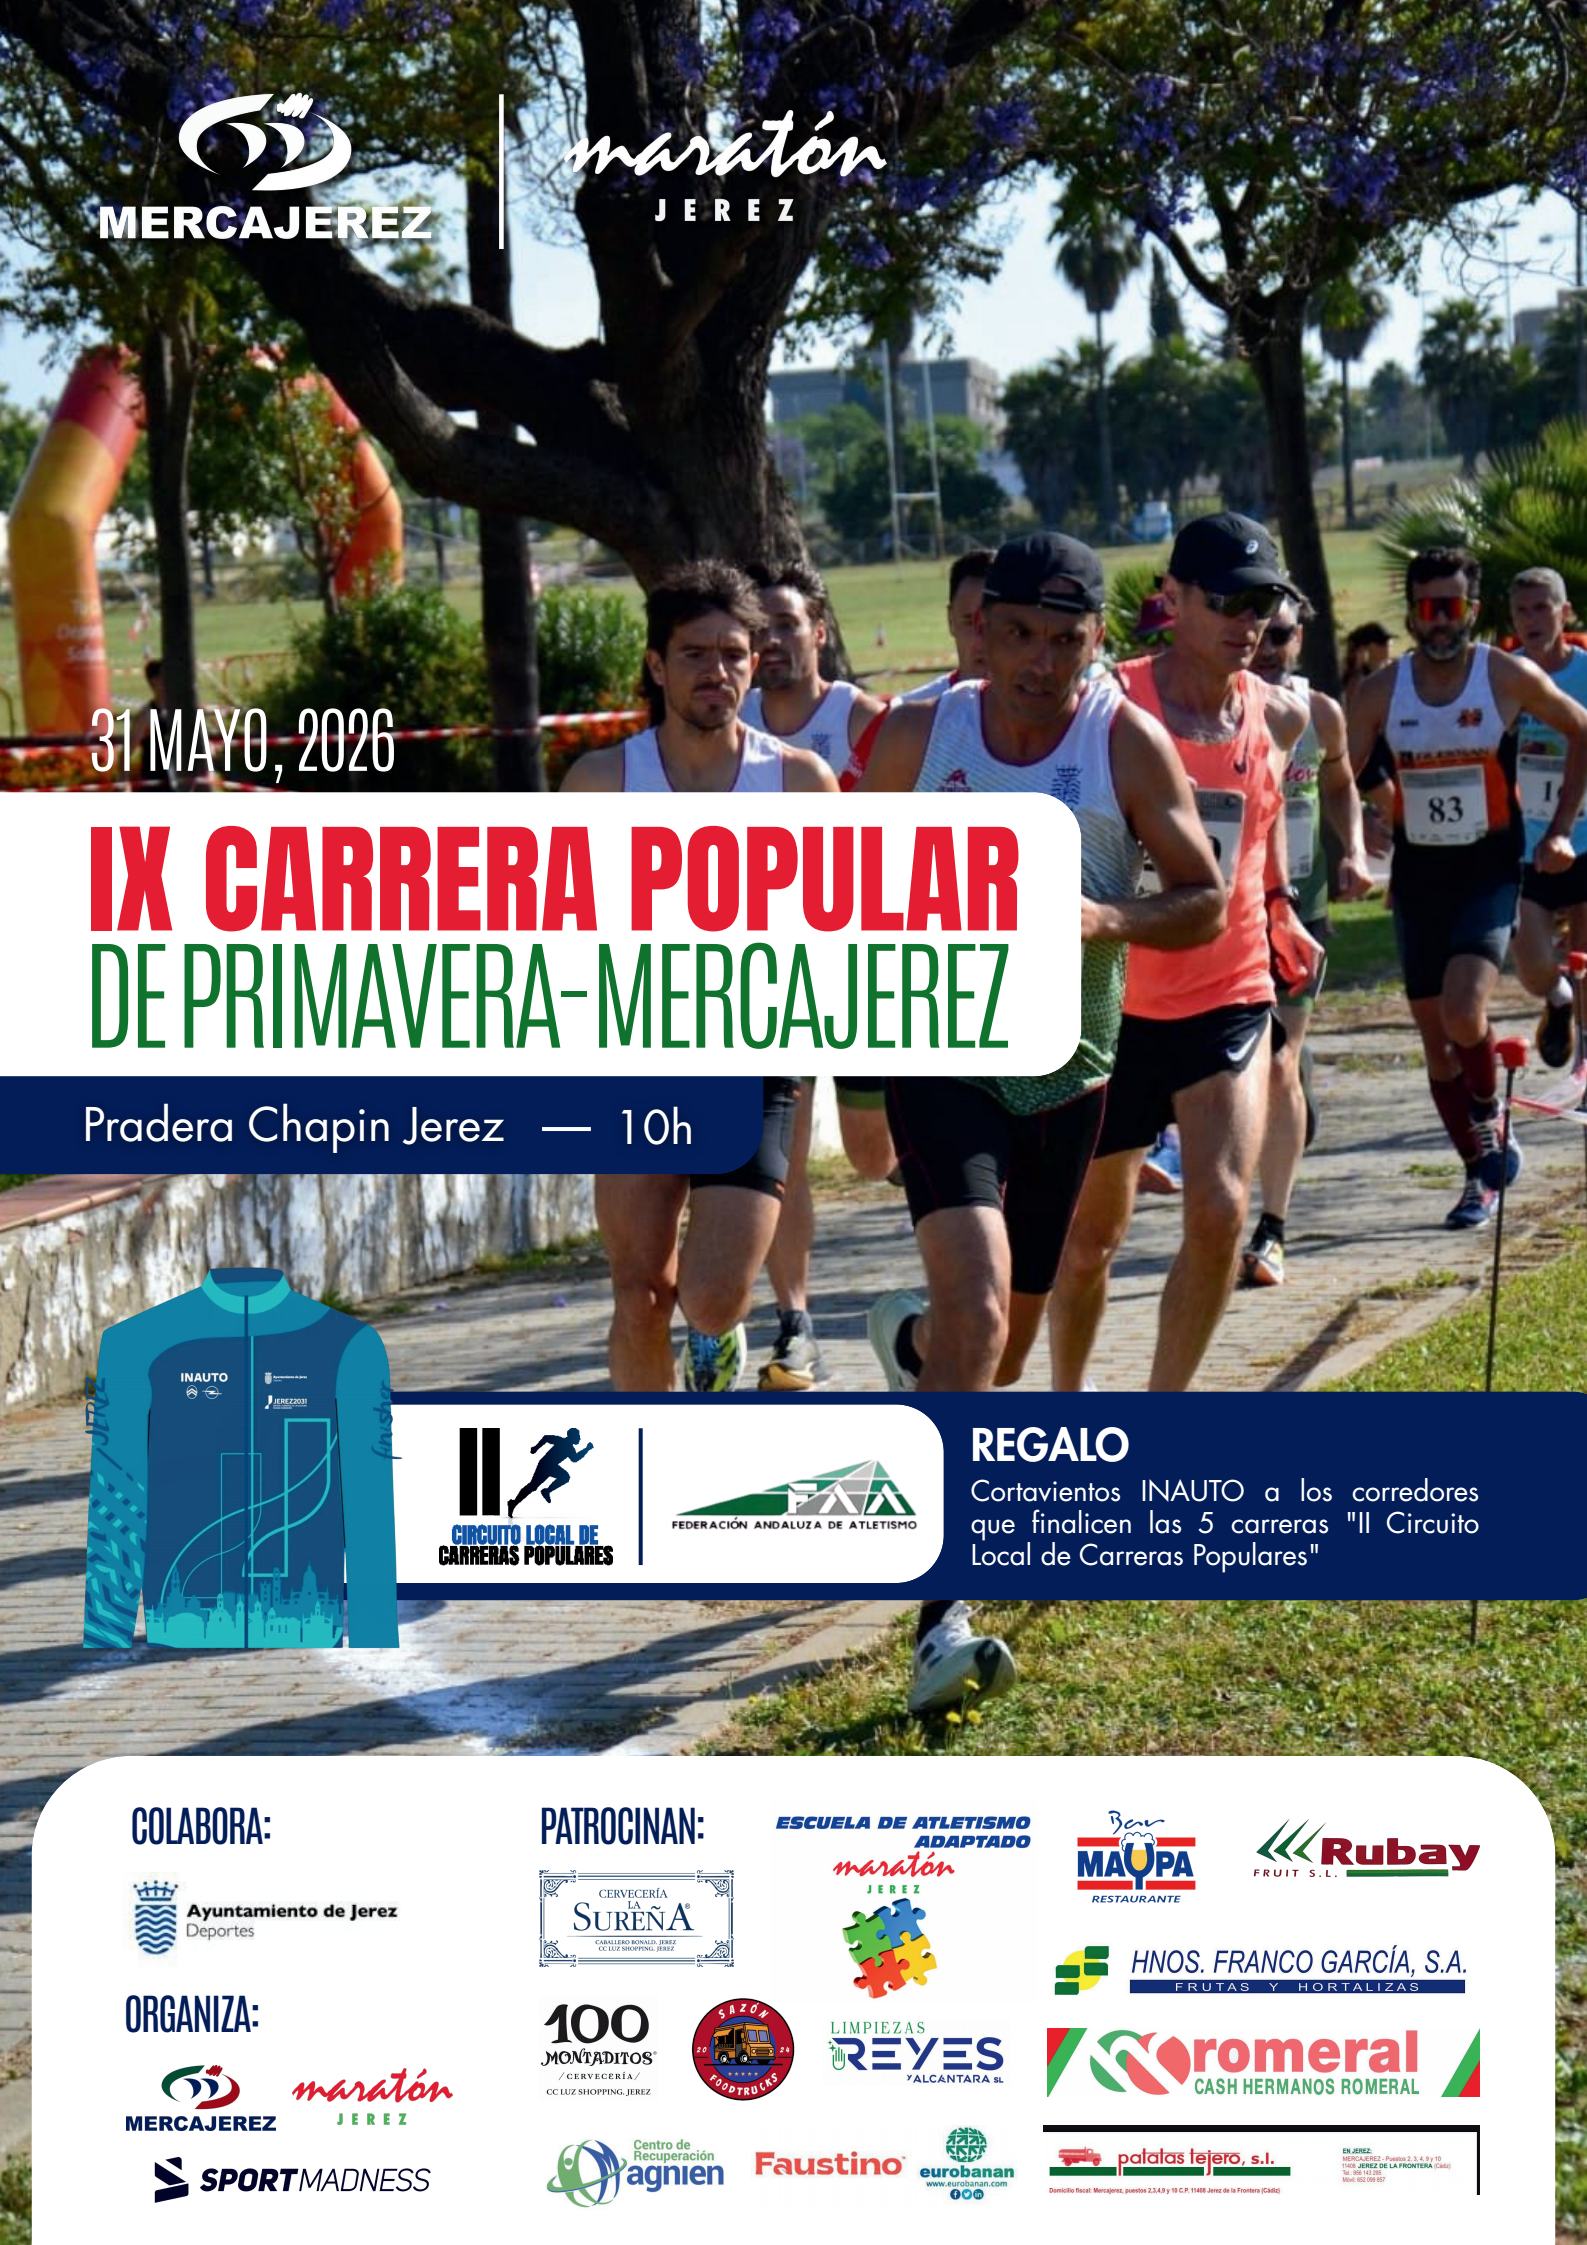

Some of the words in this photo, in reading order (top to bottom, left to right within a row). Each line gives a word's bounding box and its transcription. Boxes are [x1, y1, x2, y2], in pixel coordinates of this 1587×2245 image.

[563, 110, 887, 177] maratón
[654, 198, 795, 222] JEREZ
[98, 206, 433, 241] MERCAJEREZ
[89, 706, 134, 772] 31
[148, 706, 285, 784] MAYO,
[297, 706, 396, 773] 2026
[1428, 796, 1464, 824] 83
[91, 826, 172, 931] IX
[206, 826, 597, 932] CARRERA
[631, 826, 1019, 932] POPULAR
[92, 944, 166, 1048] DE
[184, 942, 1009, 1049] PRIMAVERA-MERCAJEREZ
[86, 1104, 232, 1142] Pradera
[249, 1103, 389, 1153] Chapin
[403, 1107, 504, 1145] Jerez
[622, 1107, 691, 1145] 10h
[181, 1373, 228, 1382] INAUTO
[973, 1427, 1129, 1462] REGALO
[971, 1479, 1120, 1502] Cortavientos
[1142, 1479, 1244, 1502] INAUTO
[1265, 1487, 1279, 1502] a
[1301, 1478, 1332, 1502] los
[1353, 1478, 1478, 1502] corredores
[450, 1522, 523, 1546] CIRCUITO
[526, 1524, 574, 1546] LOCAL
[579, 1525, 598, 1545] DE
[672, 1515, 750, 1529] FEDERACIÓN
[754, 1521, 821, 1529] ANDALUZA
[828, 1521, 842, 1529] DE
[849, 1521, 917, 1529] ATLETISMO
[971, 1519, 1015, 1541] que
[1032, 1509, 1131, 1534] finalicen
[1150, 1510, 1181, 1534] las
[1199, 1512, 1213, 1534] 5
[1232, 1519, 1328, 1534] carreras
[1348, 1512, 1369, 1533] "II
[1387, 1511, 1479, 1534] Circuito
[439, 1544, 519, 1566] CARRERAS
[524, 1544, 613, 1566] POPULARES
[972, 1540, 1030, 1566] Local
[1041, 1542, 1071, 1566] de
[1080, 1543, 1183, 1566] Carreras
[1194, 1542, 1318, 1573] Populares"
[132, 1807, 270, 1845] COLABORA:
[542, 1807, 704, 1845] PATROCINAN:
[776, 1816, 870, 1829] ESCUELA
[878, 1817, 907, 1829] DE
[912, 1816, 1030, 1829] ATLETISMO
[914, 1835, 1031, 1848] ADAPTADO
[833, 1851, 955, 1877] maratón
[1321, 1838, 1480, 1872] Rubay
[1254, 1869, 1299, 1877] FRUIT
[599, 1888, 667, 1898] CERVECERÍA
[867, 1885, 919, 1894] JEREZ
[187, 1904, 318, 1921] Ayuntamiento
[324, 1904, 345, 1917] de
[350, 1904, 397, 1921] Jerez
[573, 1902, 695, 1931] SUREÑA
[626, 1900, 642, 1910] LA
[187, 1920, 254, 1940] Deportes
[1132, 1950, 1204, 1973] HNOS.
[1214, 1950, 1313, 1973] FRANCO
[1321, 1945, 1415, 1977] GARCÍA,
[1425, 1950, 1466, 1973] S.A.
[1176, 1983, 1249, 1991] FRUTAS
[1269, 1983, 1278, 1991] Y
[1299, 1983, 1418, 1991] HORTALIZAS
[126, 1995, 258, 2033] ORGANIZA:
[718, 2002, 769, 2019] SAZÓN
[544, 2004, 649, 2044] 100
[831, 2022, 925, 2034] LIMPIEZAS
[540, 2048, 653, 2066] MONTADITOS
[831, 2036, 1005, 2072] REYES
[1194, 2030, 1418, 2073] romeral
[292, 2068, 453, 2103] maratón
[565, 2071, 634, 2080] CERVECERÍA
[710, 2073, 778, 2096] FOODTRUCKS
[1195, 2078, 1237, 2094] CASH
[1243, 2078, 1334, 2095] HERMANOS
[1341, 2078, 1419, 2095] ROMERAL
[126, 2116, 276, 2131] MERCAJEREZ
[337, 2113, 406, 2125] JEREZ
[632, 2138, 674, 2150] Centro
[676, 2139, 690, 2150] de
[632, 2150, 716, 2164] Recuperación
[756, 2151, 904, 2175] Faustino
[1251, 2152, 1274, 2164] s.l.
[200, 2168, 431, 2192] SPORTMADNESS
[920, 2165, 1014, 2178] eurobanan
